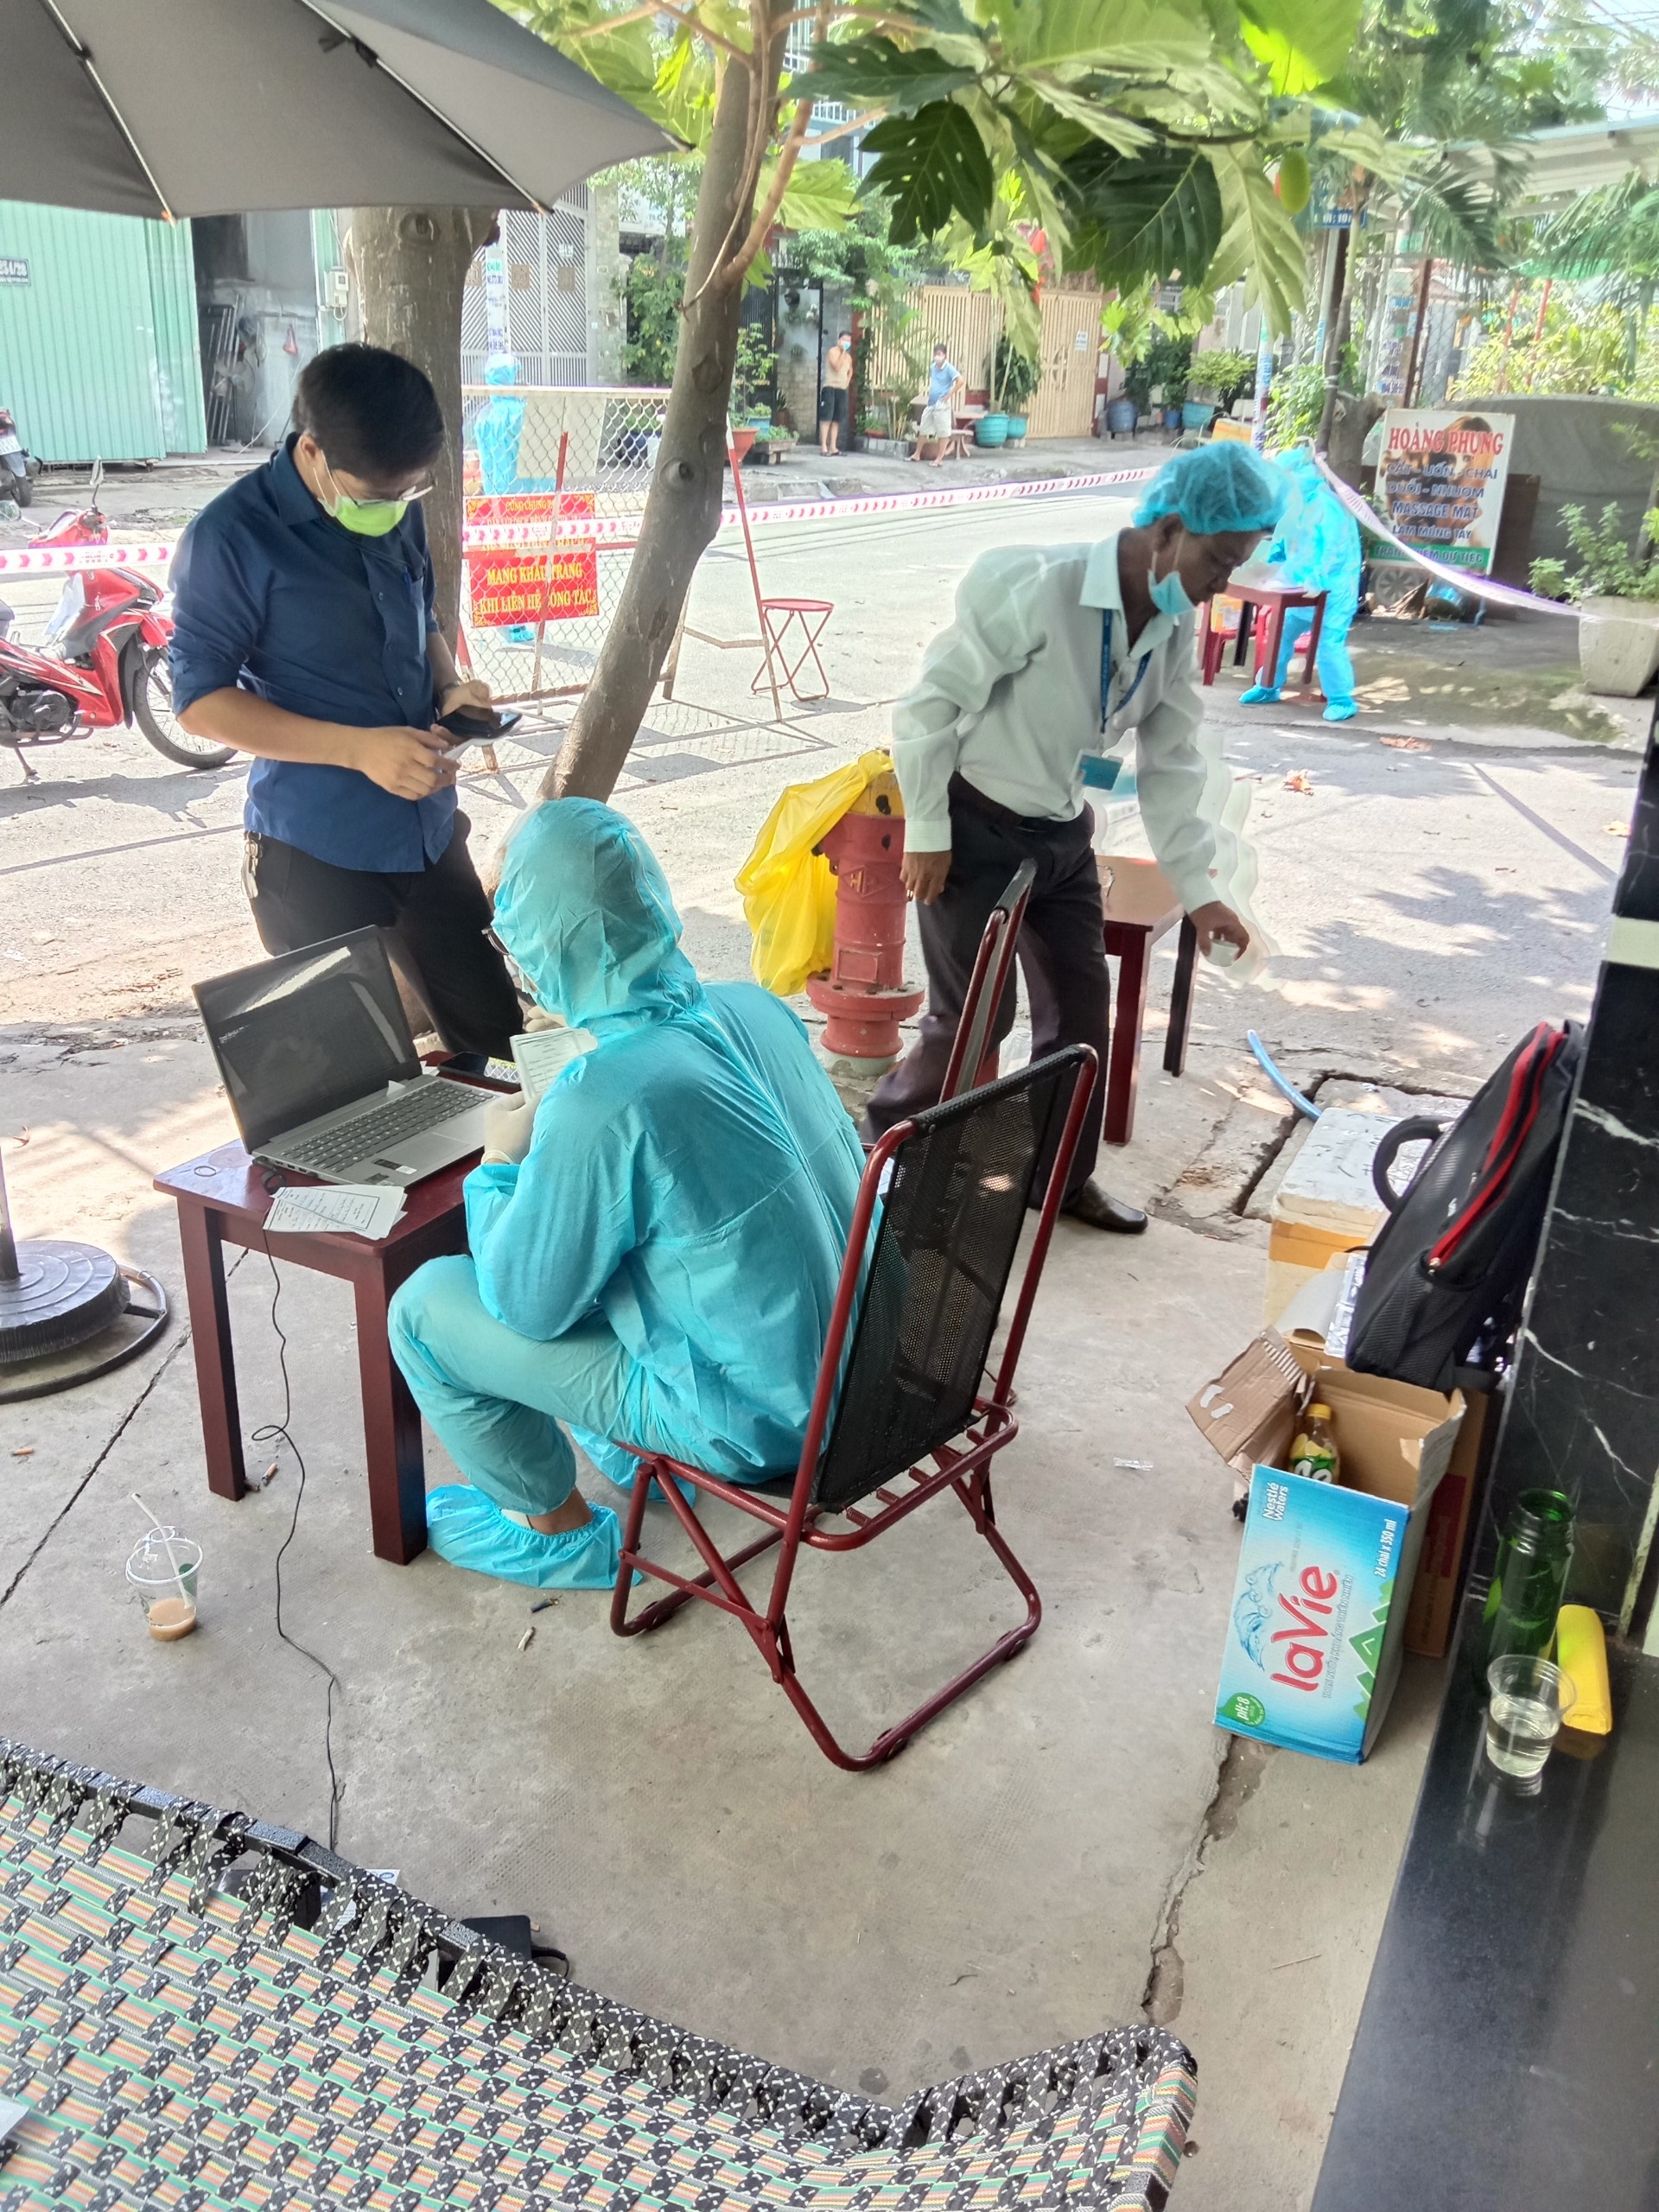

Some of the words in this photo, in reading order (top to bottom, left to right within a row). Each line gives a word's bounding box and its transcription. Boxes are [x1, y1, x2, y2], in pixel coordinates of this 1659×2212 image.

[1392, 501, 1450, 518] MASSAGE
[1453, 529, 1471, 539] TAY
[487, 567, 518, 586] MANG
[480, 596, 499, 613] KHI
[546, 588, 570, 608] ÔNG
[1262, 1482, 1279, 1521] Nestlé
[1273, 1485, 1288, 1521] Waters
[1383, 1518, 1397, 1531] ml
[1380, 1530, 1395, 1545] 350
[1374, 1566, 1387, 1578] 24
[1235, 1696, 1249, 1720] pH:8
